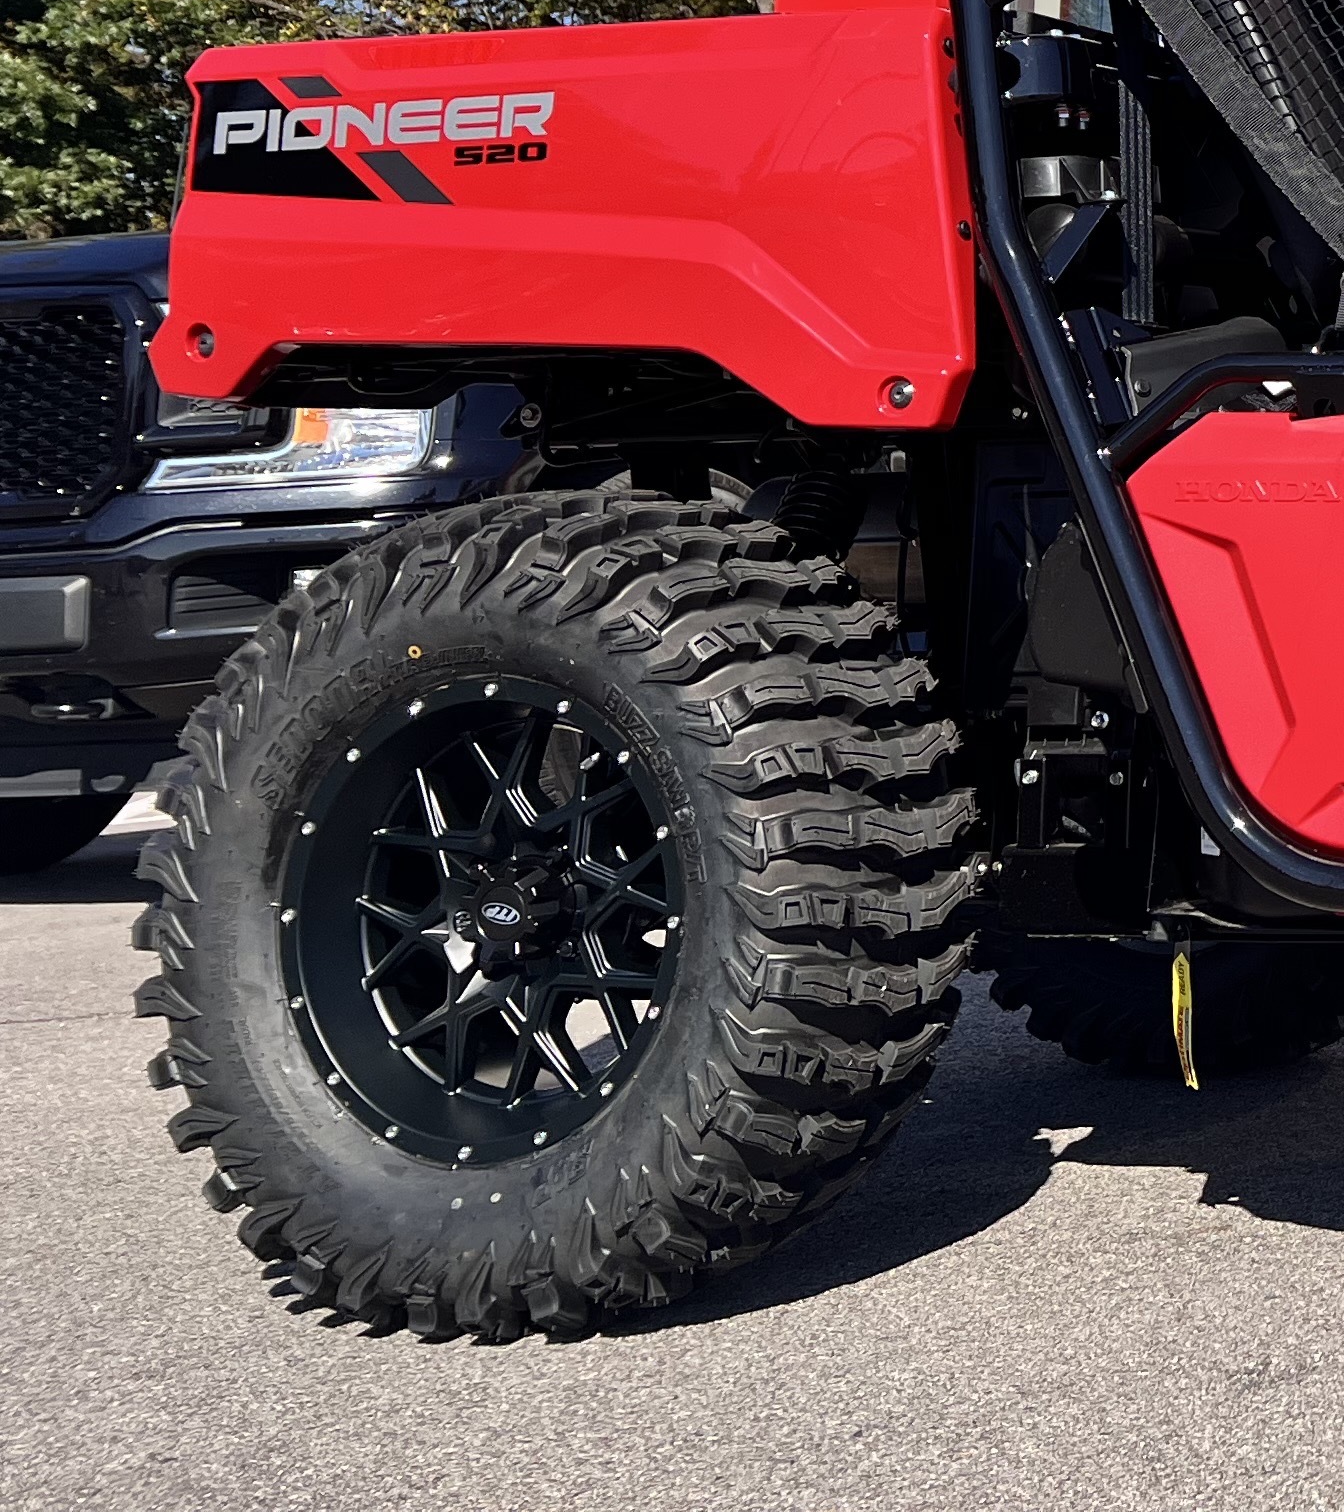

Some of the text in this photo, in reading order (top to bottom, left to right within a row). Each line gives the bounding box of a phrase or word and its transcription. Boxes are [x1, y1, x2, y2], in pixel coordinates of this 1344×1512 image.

[213, 91, 556, 155] PIONEER
[454, 141, 548, 167] 520
[1174, 480, 1343, 503] HONDA
